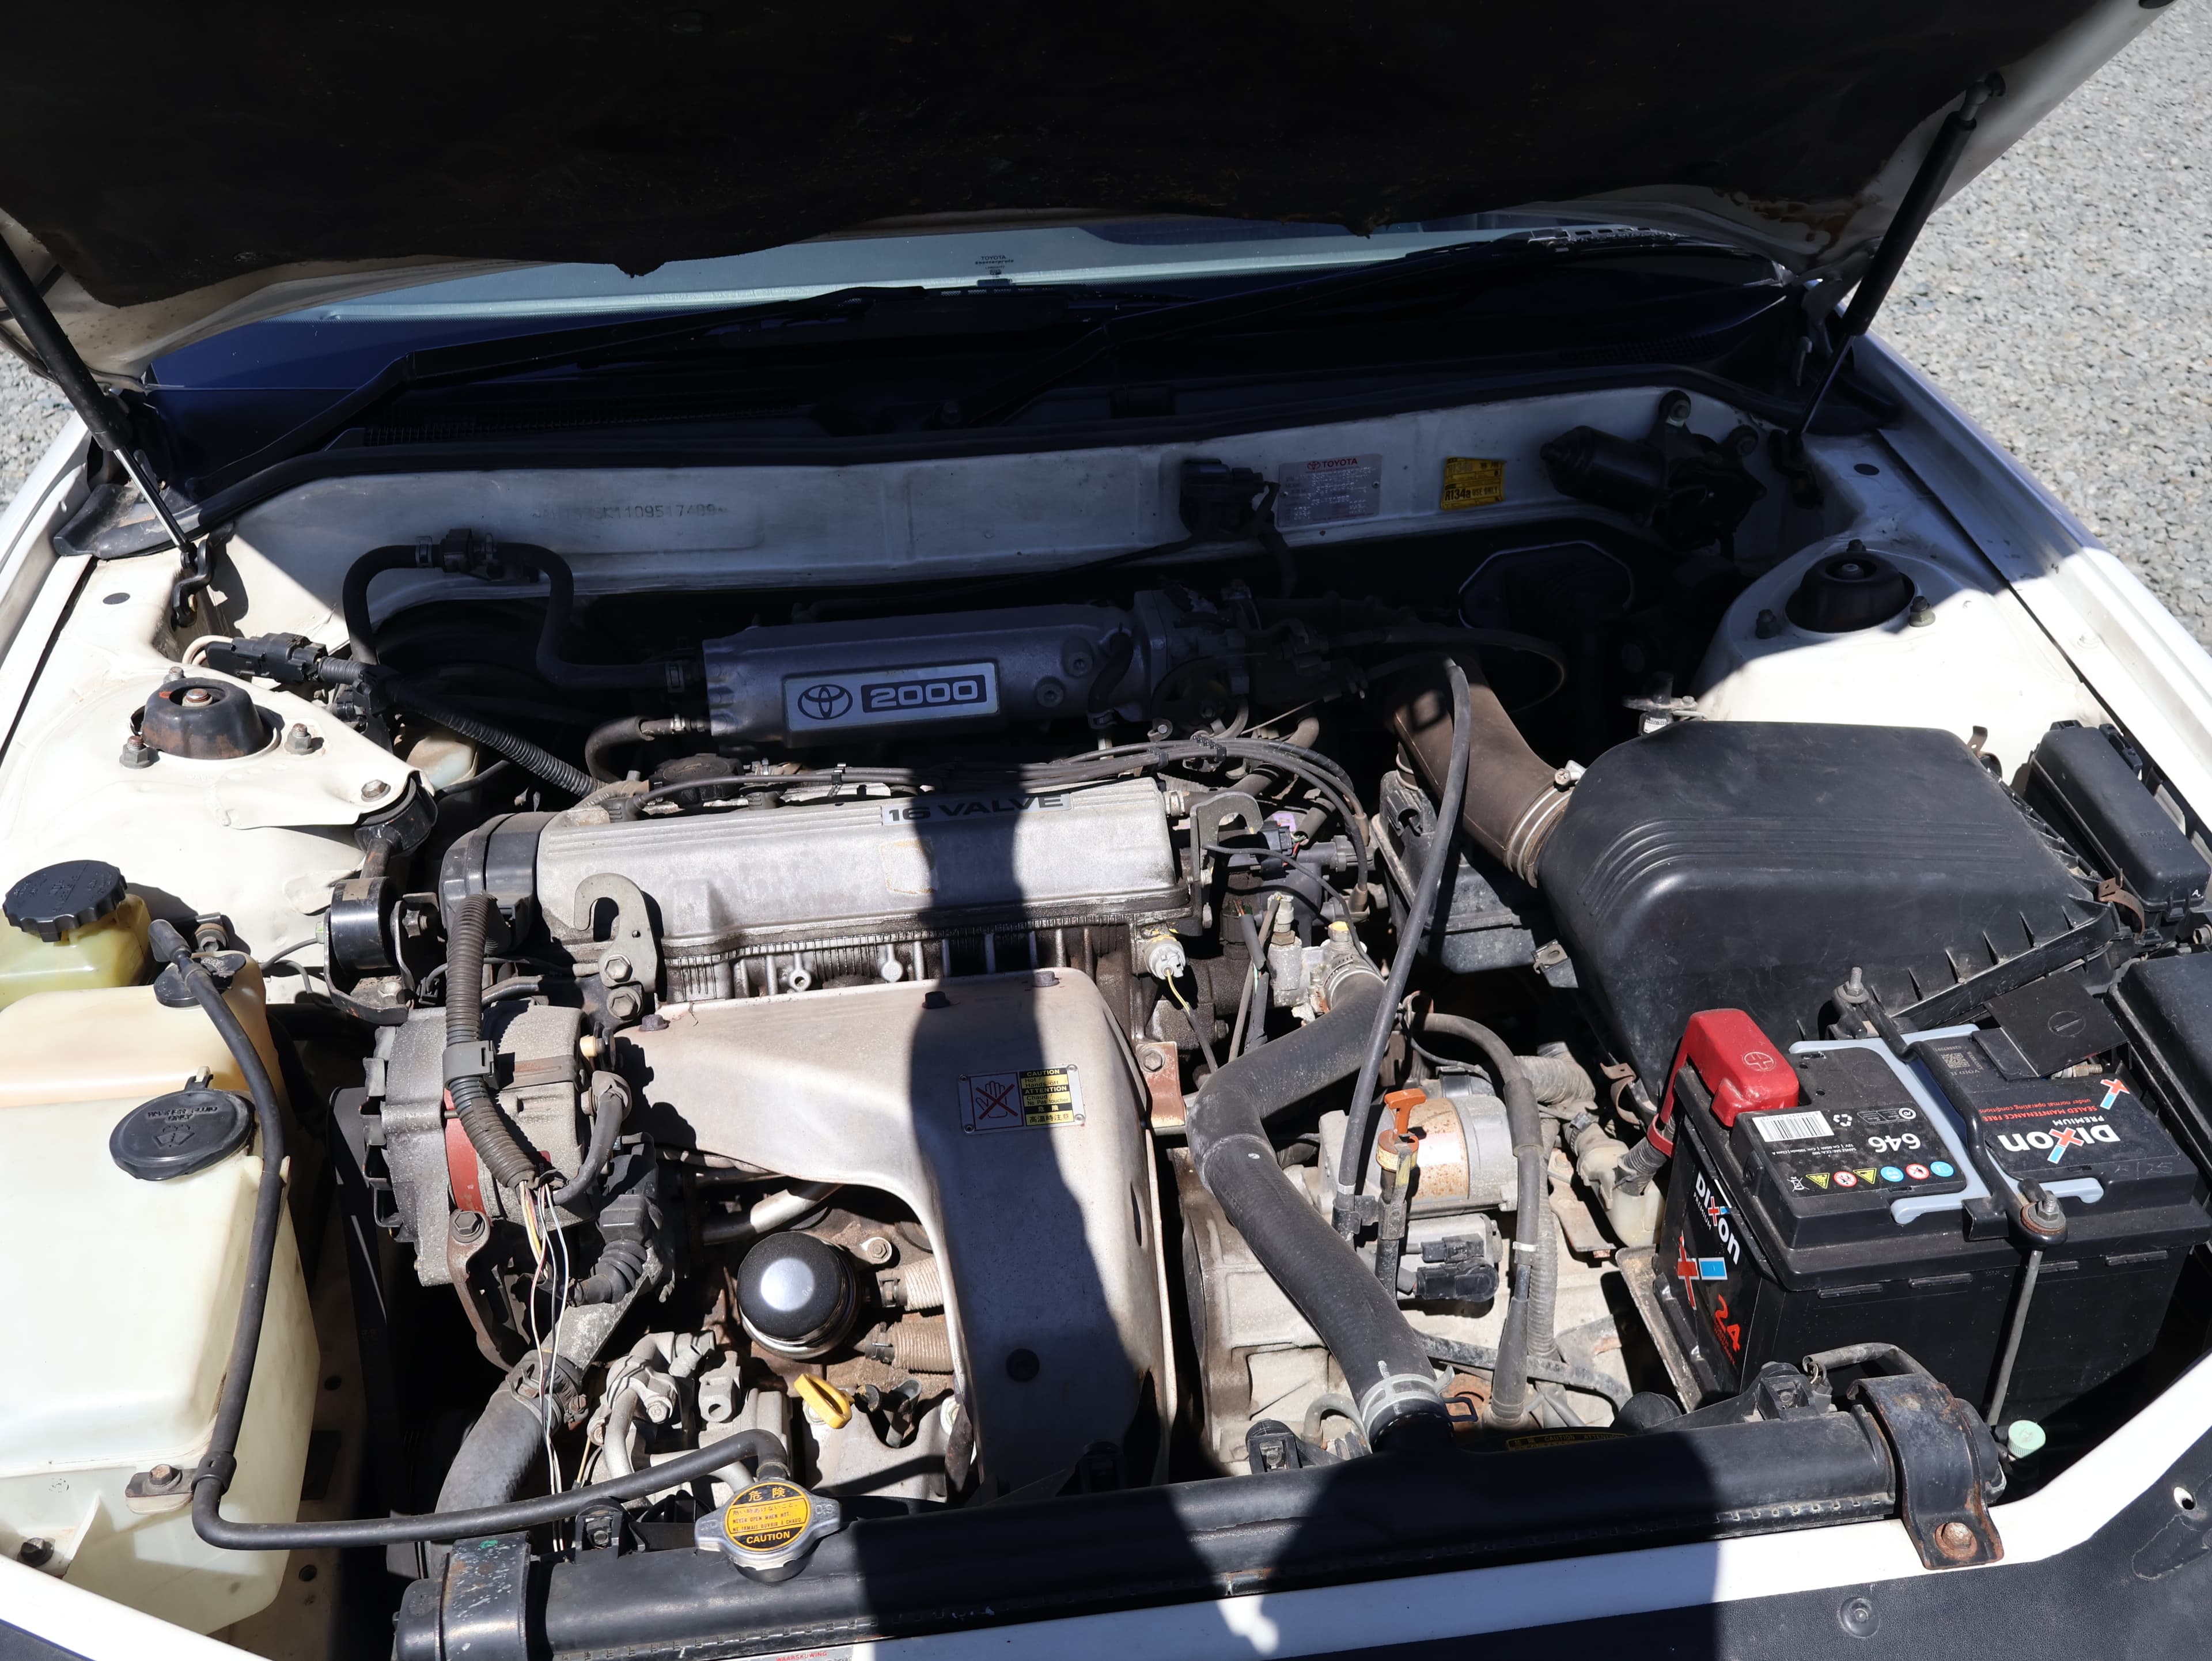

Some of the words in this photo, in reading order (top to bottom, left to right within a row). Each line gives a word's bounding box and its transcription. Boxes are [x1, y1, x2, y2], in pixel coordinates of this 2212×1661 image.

[1323, 458, 1358, 468] TOYOTA
[1445, 489, 1471, 501] R134a
[870, 680, 978, 708] 2000
[889, 807, 931, 822] 16
[937, 794, 1064, 816] VALVE
[1027, 1069, 1060, 1077] CAUTION
[1025, 1085, 1067, 1095] ATTENTION
[2014, 1102, 2046, 1112] operating
[2047, 1100, 2071, 1108] normal
[2072, 1098, 2091, 1106] under
[1979, 1105, 2013, 1115] conditions
[2004, 1108, 2066, 1119] MAINTENANCE
[2067, 1105, 2097, 1114] SEALED
[1982, 1114, 2003, 1122] FREE
[2052, 1115, 2104, 1126] PREMIUM
[1868, 1133, 1921, 1153] 646
[1693, 1192, 1712, 1231] PREMIUM
[1714, 1295, 1741, 1353] 24
[749, 1486, 786, 1501] 危険
[746, 1531, 791, 1545] CAUTION
[776, 1651, 827, 1661] WAARSKUWING
